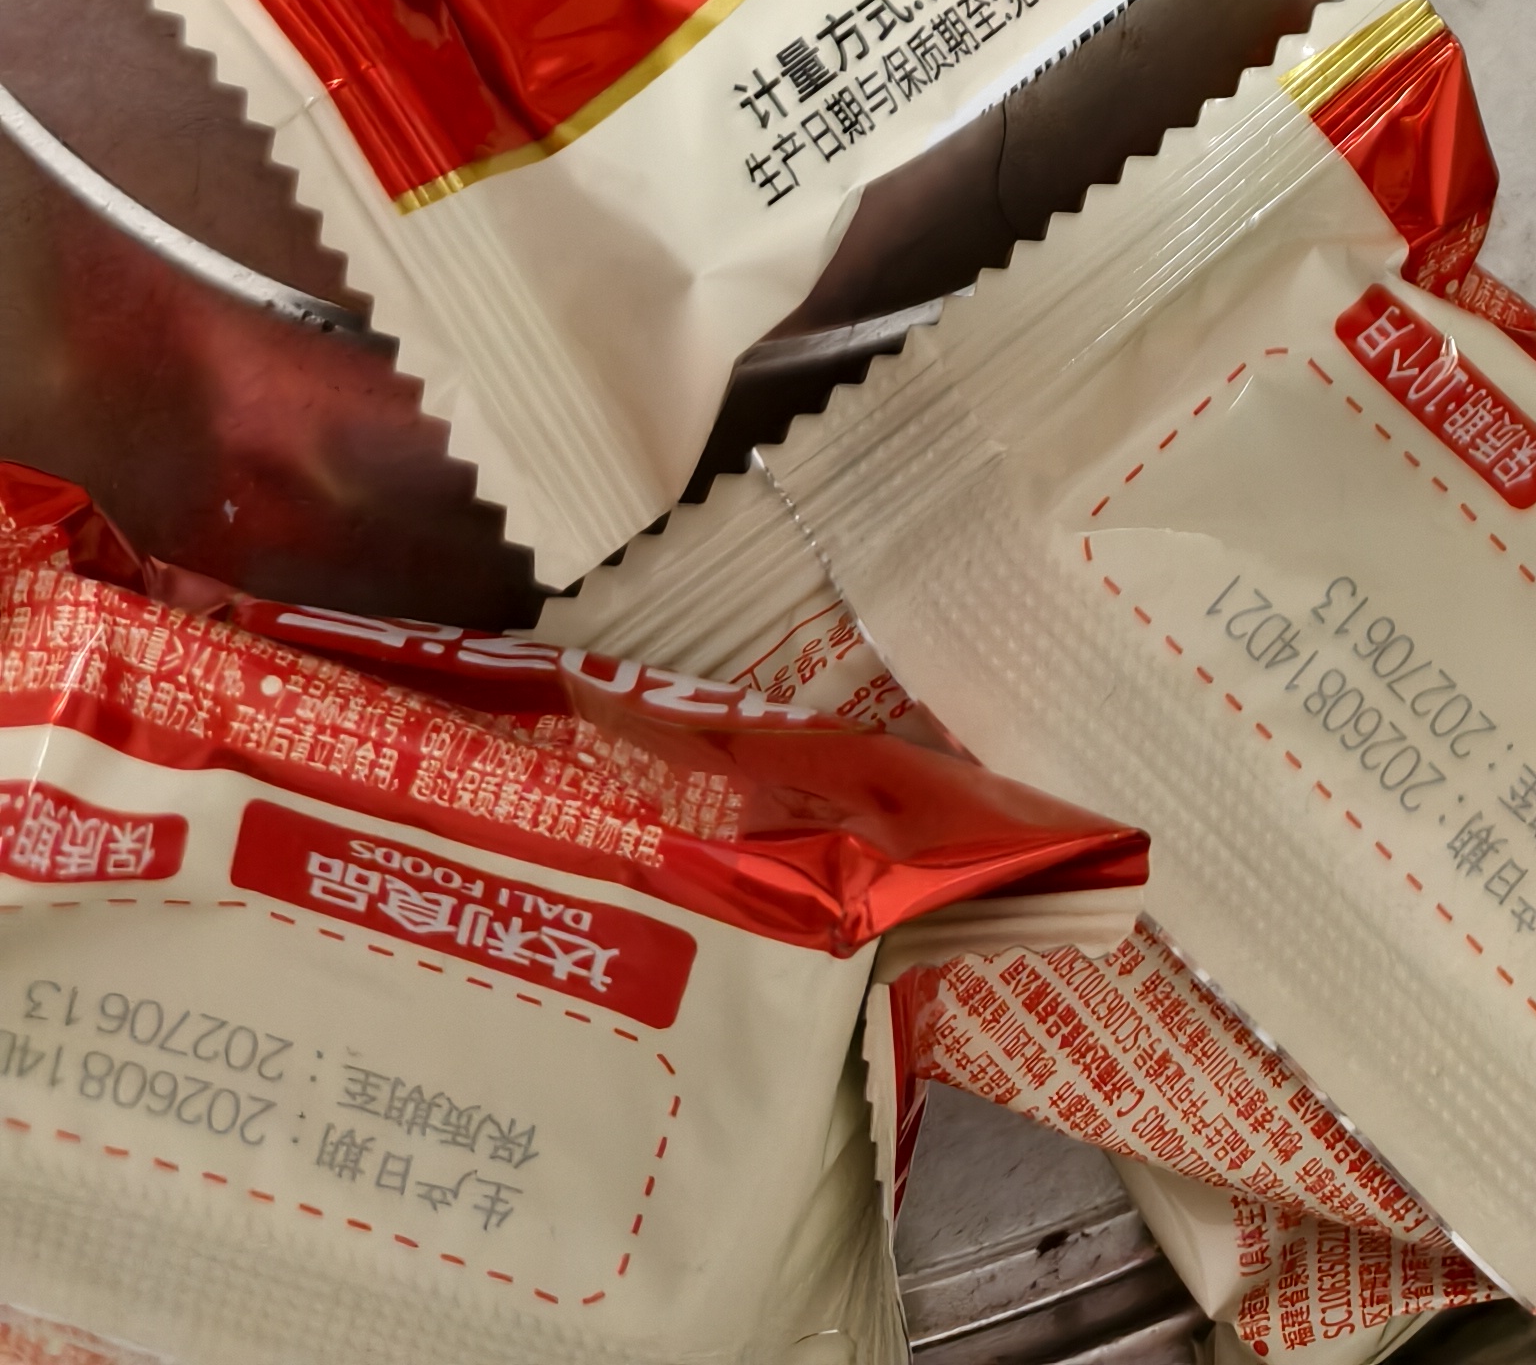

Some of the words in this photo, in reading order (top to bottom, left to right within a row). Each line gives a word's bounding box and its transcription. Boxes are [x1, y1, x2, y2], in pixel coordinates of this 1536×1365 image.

[349, 839, 486, 896] FOODS
[497, 885, 593, 931] DALI
[307, 850, 621, 993] 达利食品
[998, 953, 1145, 1119] C.济南达利食品有限公司
